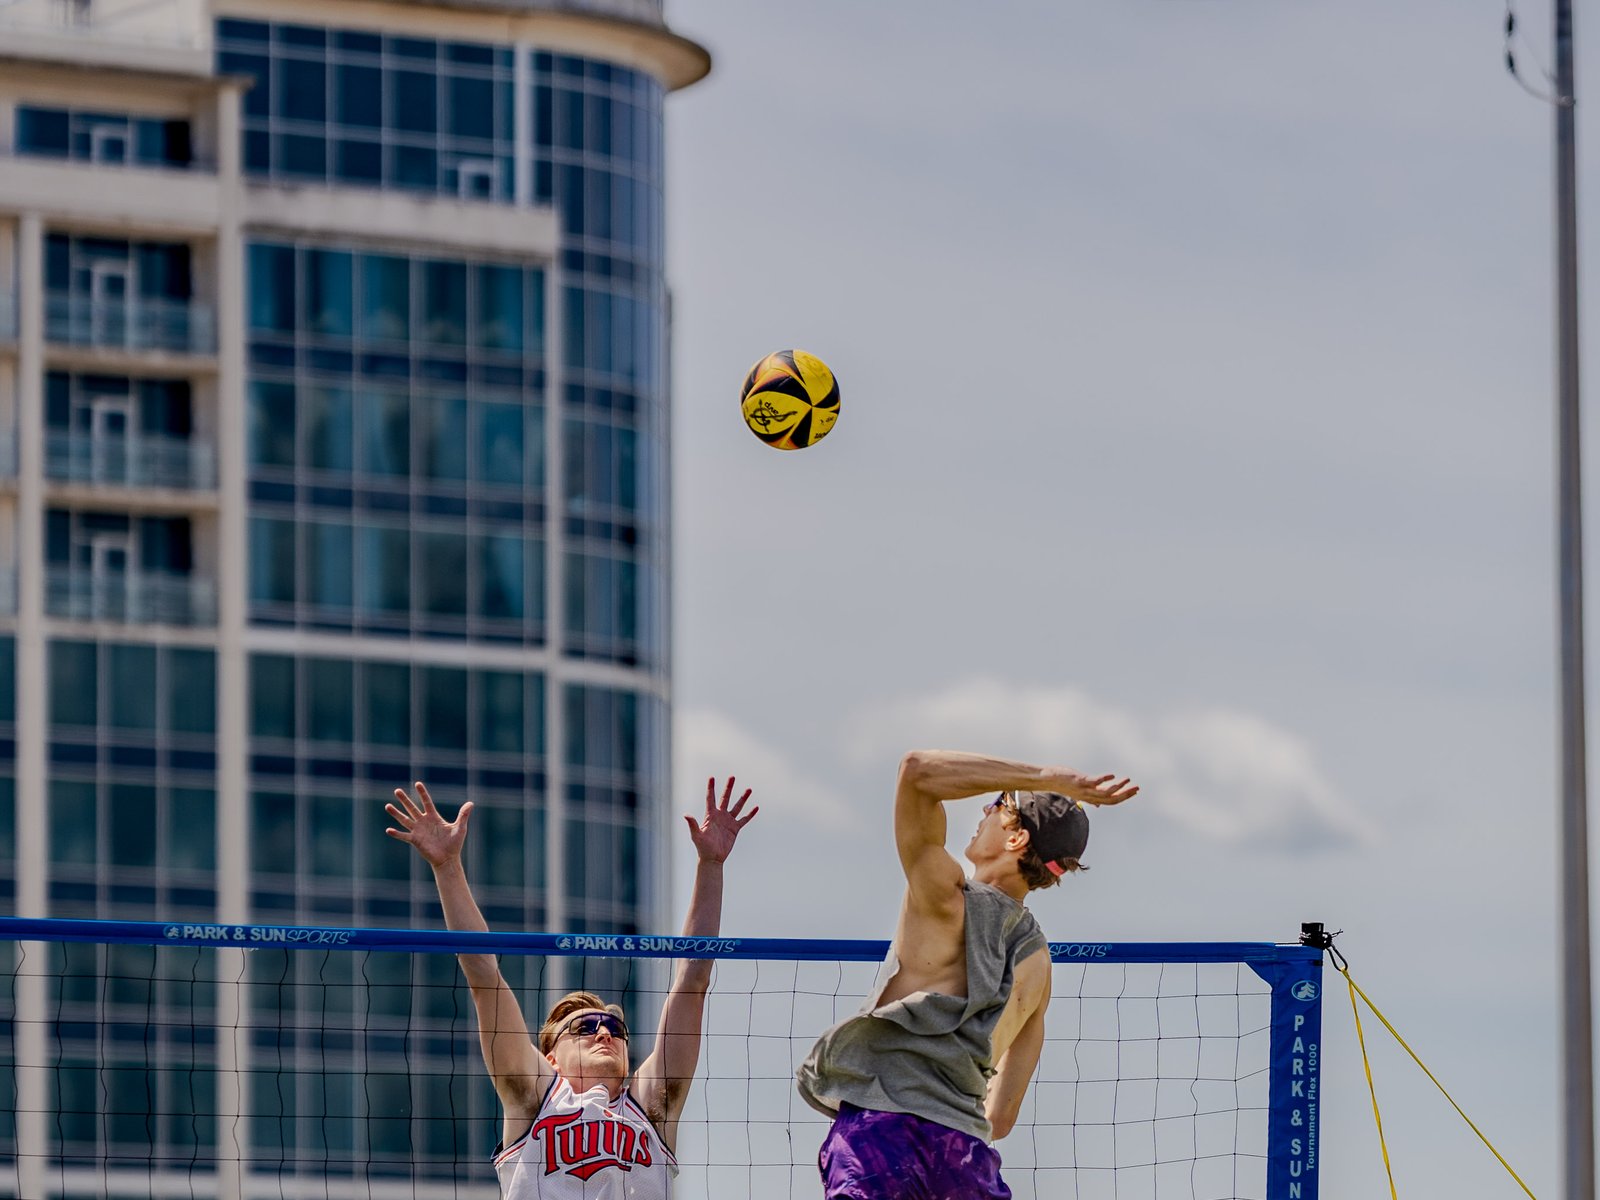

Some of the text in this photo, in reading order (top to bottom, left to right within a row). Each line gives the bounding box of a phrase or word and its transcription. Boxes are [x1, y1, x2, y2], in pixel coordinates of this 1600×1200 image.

[183, 925, 228, 940] PARK
[233, 927, 246, 941] &
[574, 936, 619, 950] PARK
[622, 937, 635, 950] &
[1306, 1043, 1317, 1171] Tournament Flex 1000
[1290, 1109, 1303, 1126] &
[532, 1107, 652, 1176] Twins
